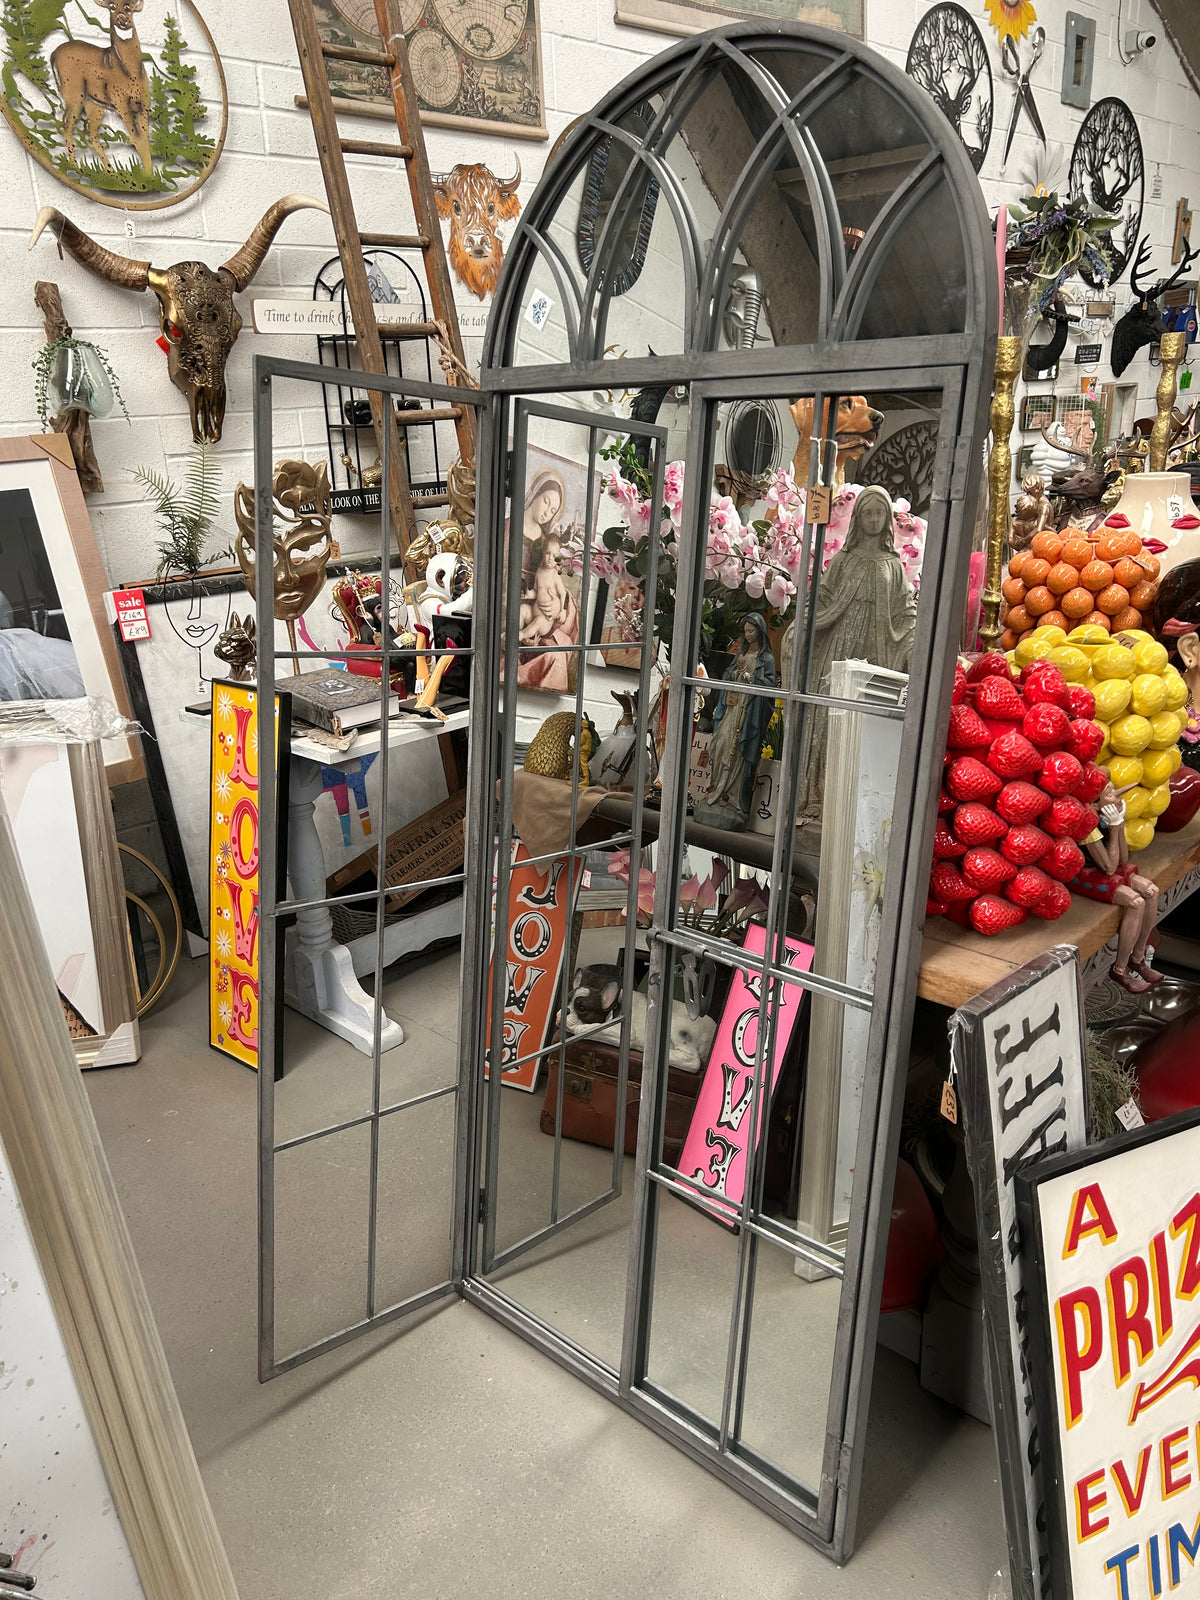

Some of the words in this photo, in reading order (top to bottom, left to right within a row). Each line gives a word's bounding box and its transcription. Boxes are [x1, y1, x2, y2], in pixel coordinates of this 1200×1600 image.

[264, 308, 291, 322] Time
[294, 312, 305, 323] to
[307, 309, 338, 327] drink
[459, 313, 470, 327] he
[472, 313, 486, 327] tab
[330, 496, 351, 509] LOOK
[364, 493, 380, 505] THE
[118, 597, 142, 608] sale
[129, 626, 147, 636] £89
[390, 855, 426, 882] FARMERS
[424, 835, 455, 859] MARKET
[225, 703, 259, 1052] LOVE
[1062, 1182, 1118, 1261] A
[1074, 1420, 1200, 1543] EVE
